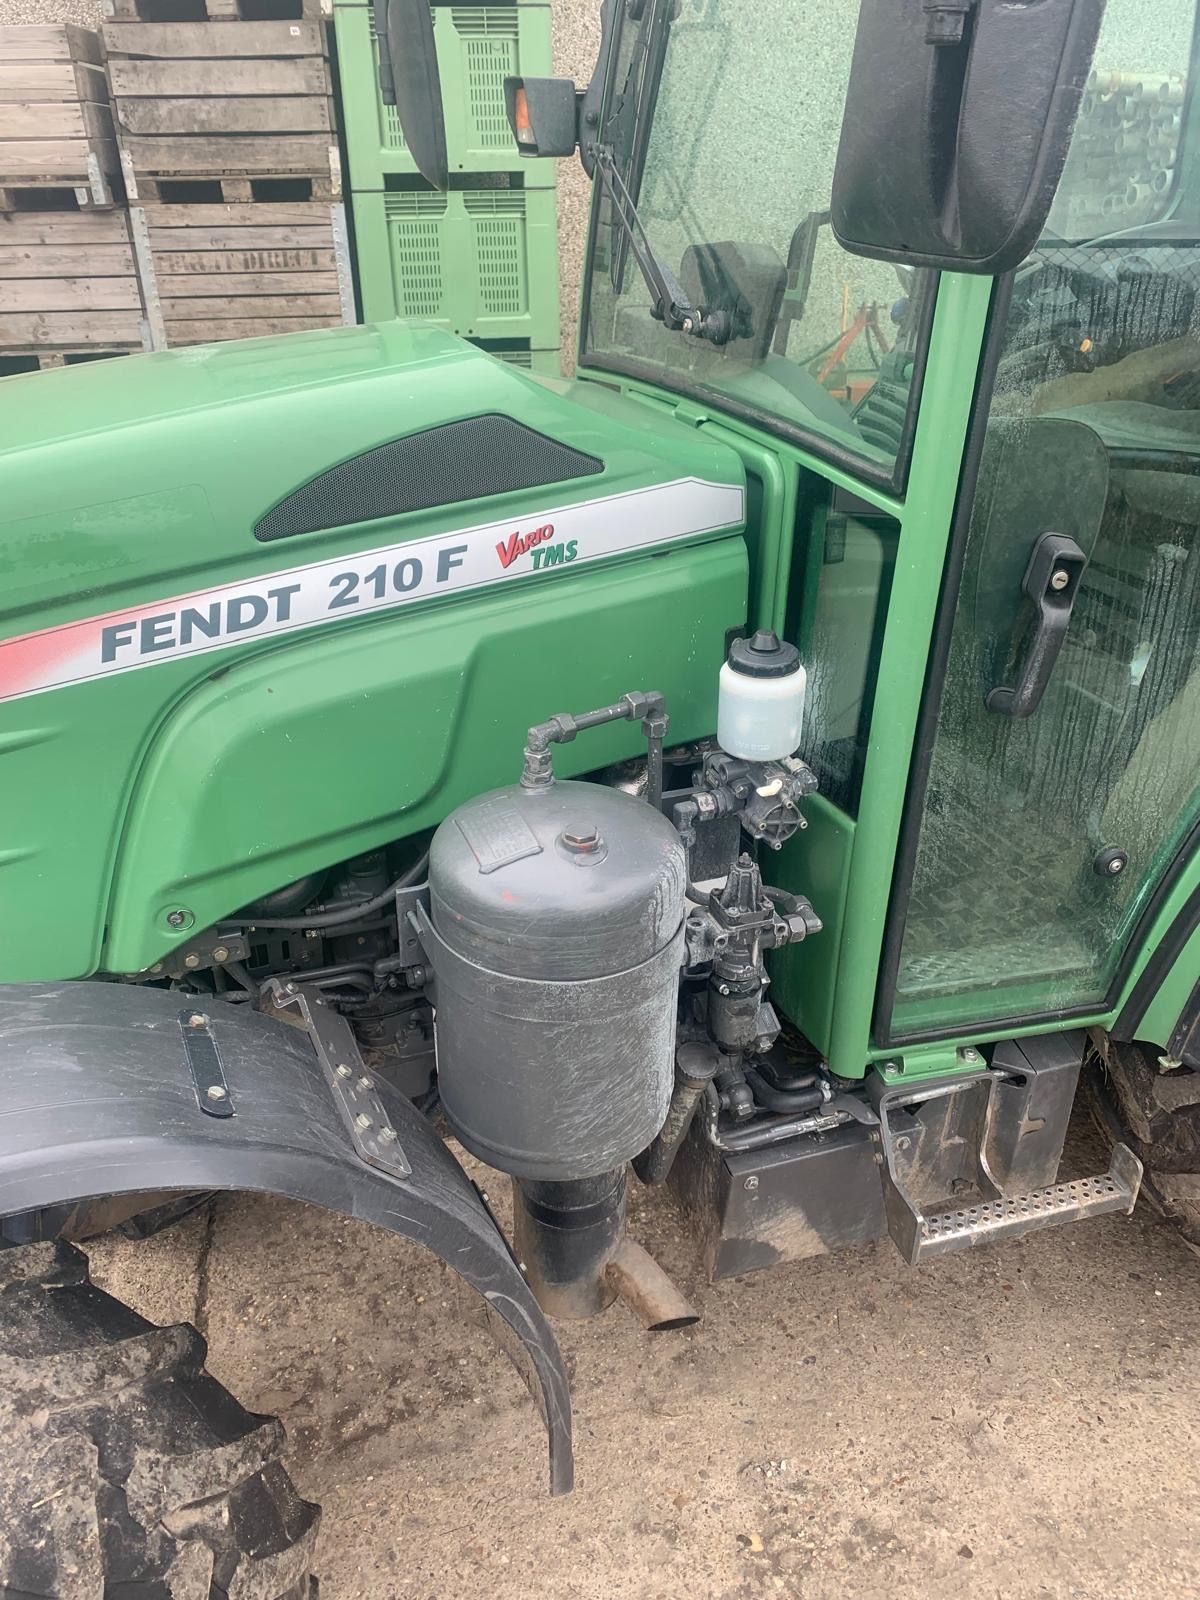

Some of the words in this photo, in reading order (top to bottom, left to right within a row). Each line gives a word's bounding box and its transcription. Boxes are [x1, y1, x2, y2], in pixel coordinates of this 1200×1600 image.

[495, 523, 555, 569] VARIO
[530, 539, 578, 570] TMS
[101, 583, 301, 664] FENDT
[327, 557, 423, 610] 210
[436, 544, 468, 583] F
